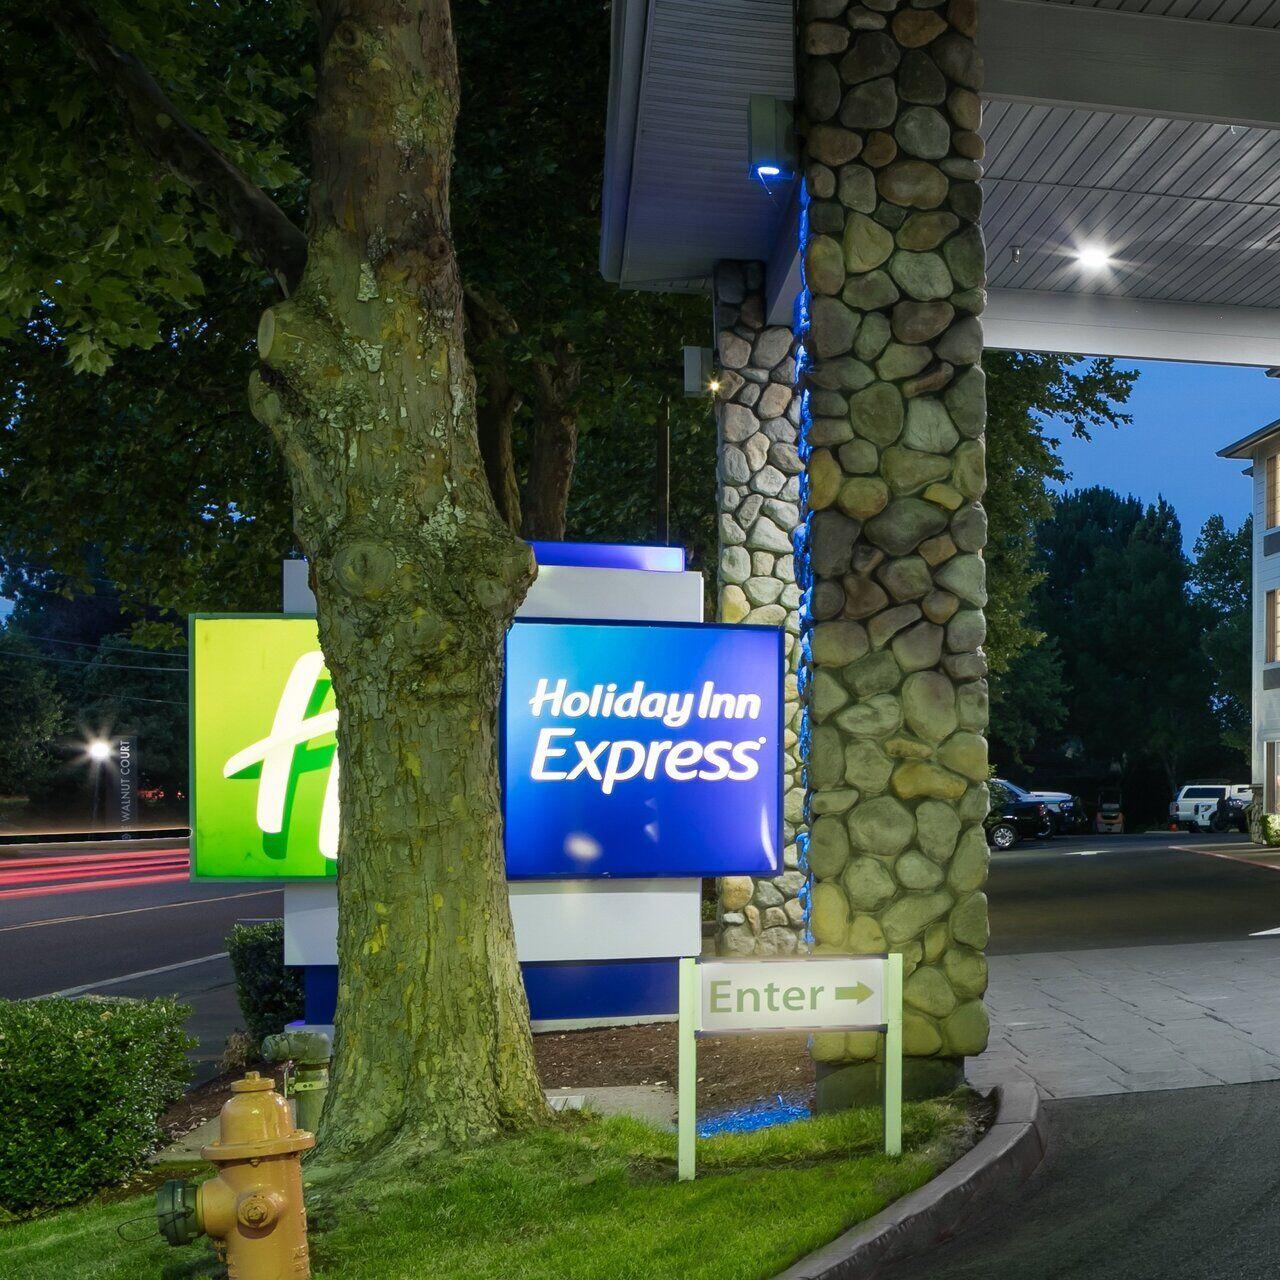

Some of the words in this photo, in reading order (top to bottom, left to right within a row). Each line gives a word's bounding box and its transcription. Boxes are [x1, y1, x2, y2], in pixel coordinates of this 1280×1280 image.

[528, 678, 695, 728] Holiday
[697, 680, 762, 720] Inn
[120, 740, 131, 775] COURT
[530, 727, 763, 795] Express
[120, 778, 131, 822] WALNUT
[709, 980, 825, 1014] Enter
